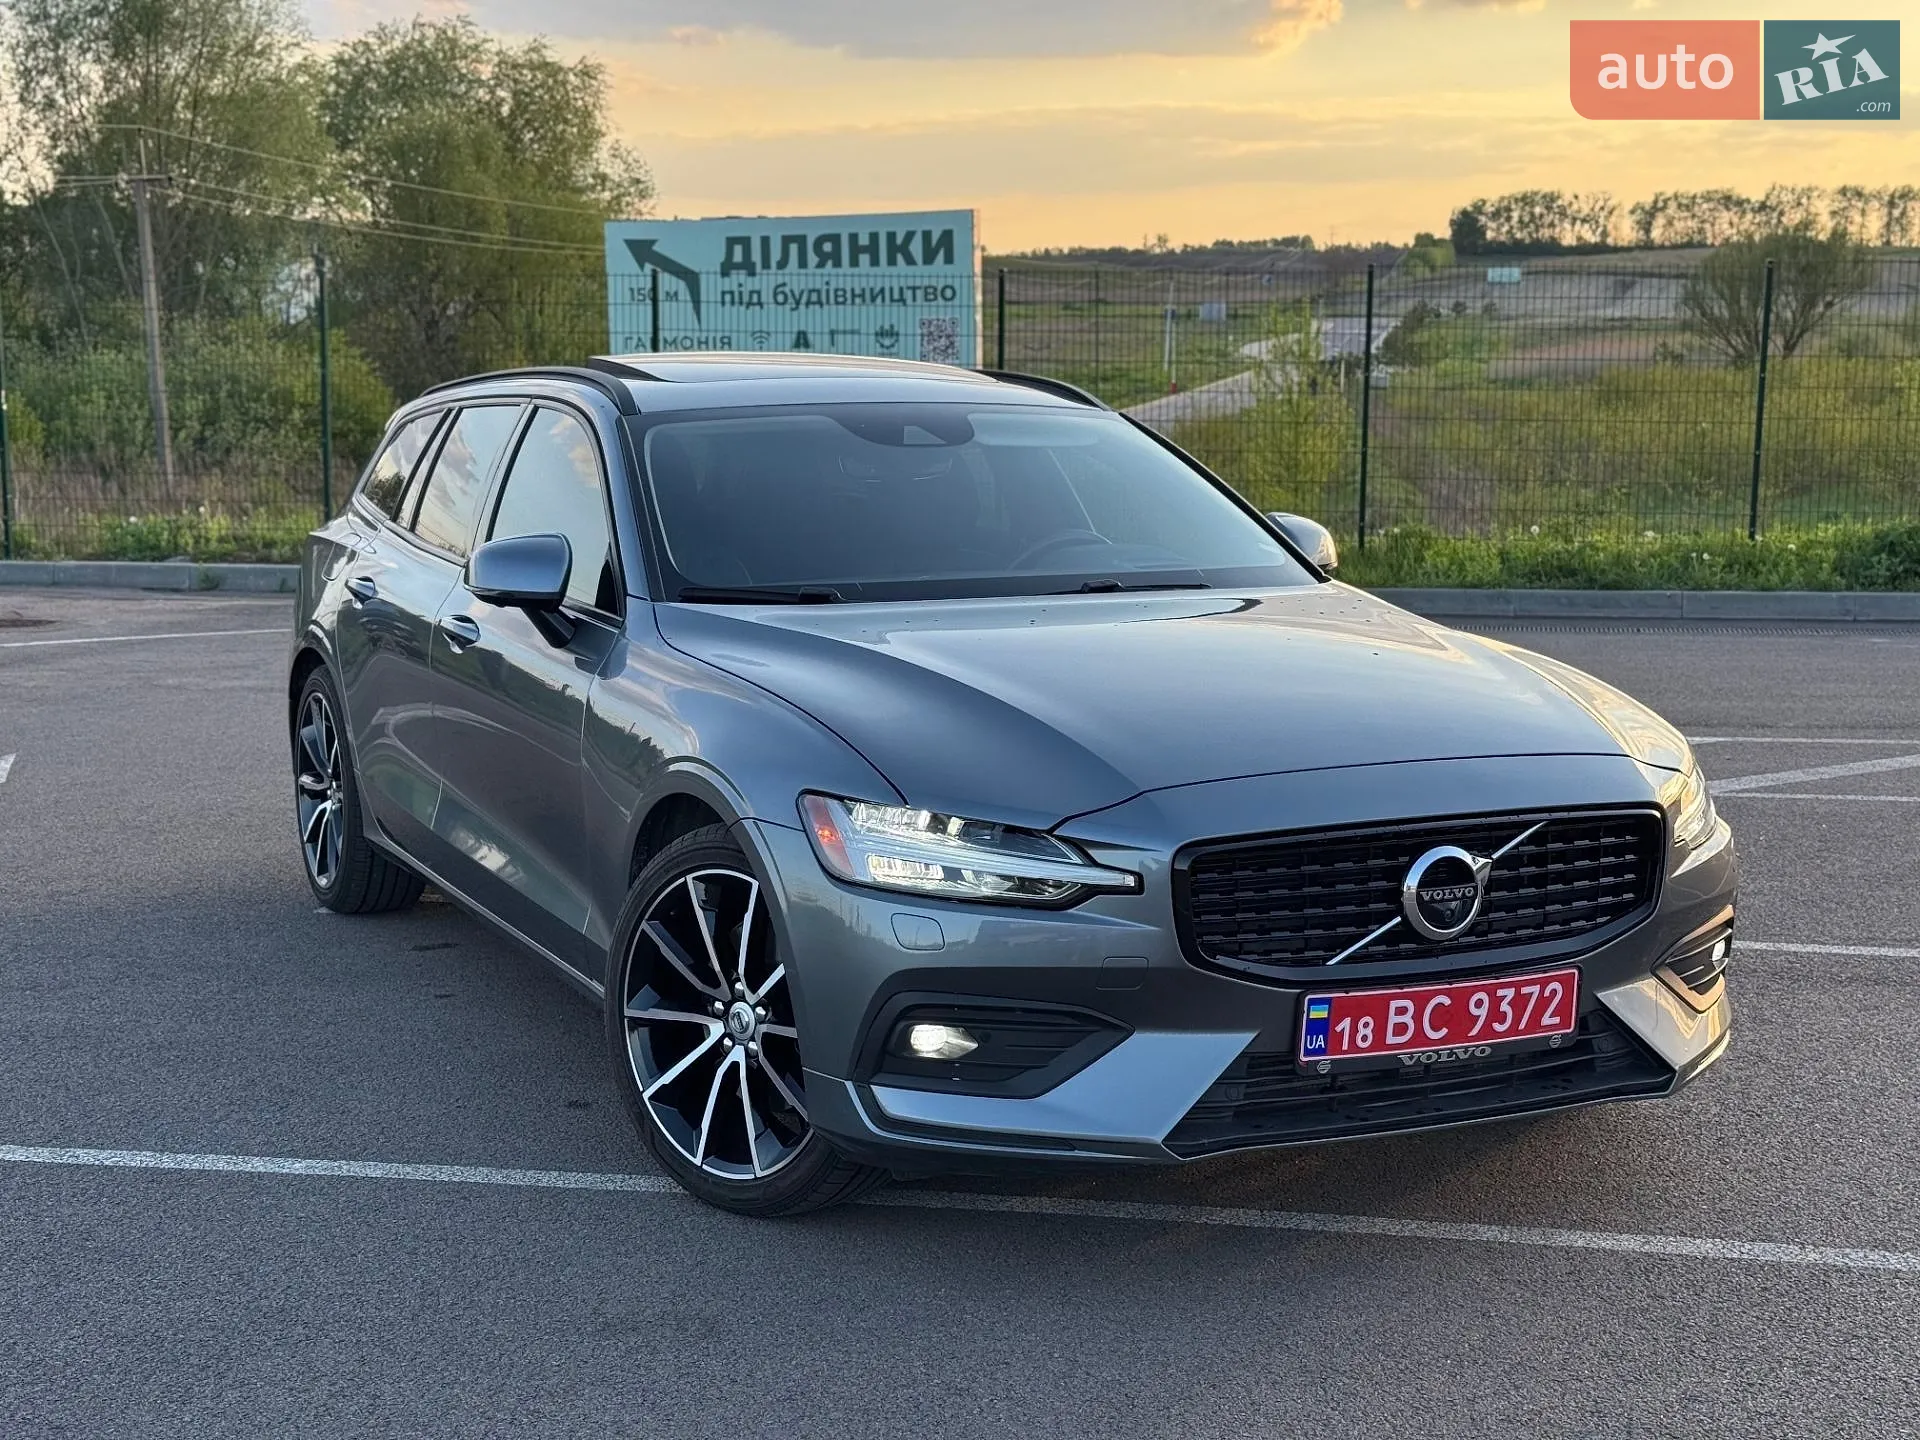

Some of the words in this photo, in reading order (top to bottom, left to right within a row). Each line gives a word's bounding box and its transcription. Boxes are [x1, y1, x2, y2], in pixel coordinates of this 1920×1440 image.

[720, 228, 955, 278] ДІЛЯНКИ
[720, 283, 764, 311] під
[772, 281, 956, 312] будівництво
[624, 335, 732, 351] ГАМОНІЯ
[1420, 887, 1475, 901] VOLVO
[1335, 1016, 1375, 1050] 18
[1467, 981, 1564, 1037] 9372
[1307, 1034, 1325, 1049] UA
[1397, 1046, 1492, 1066] VOLVO
